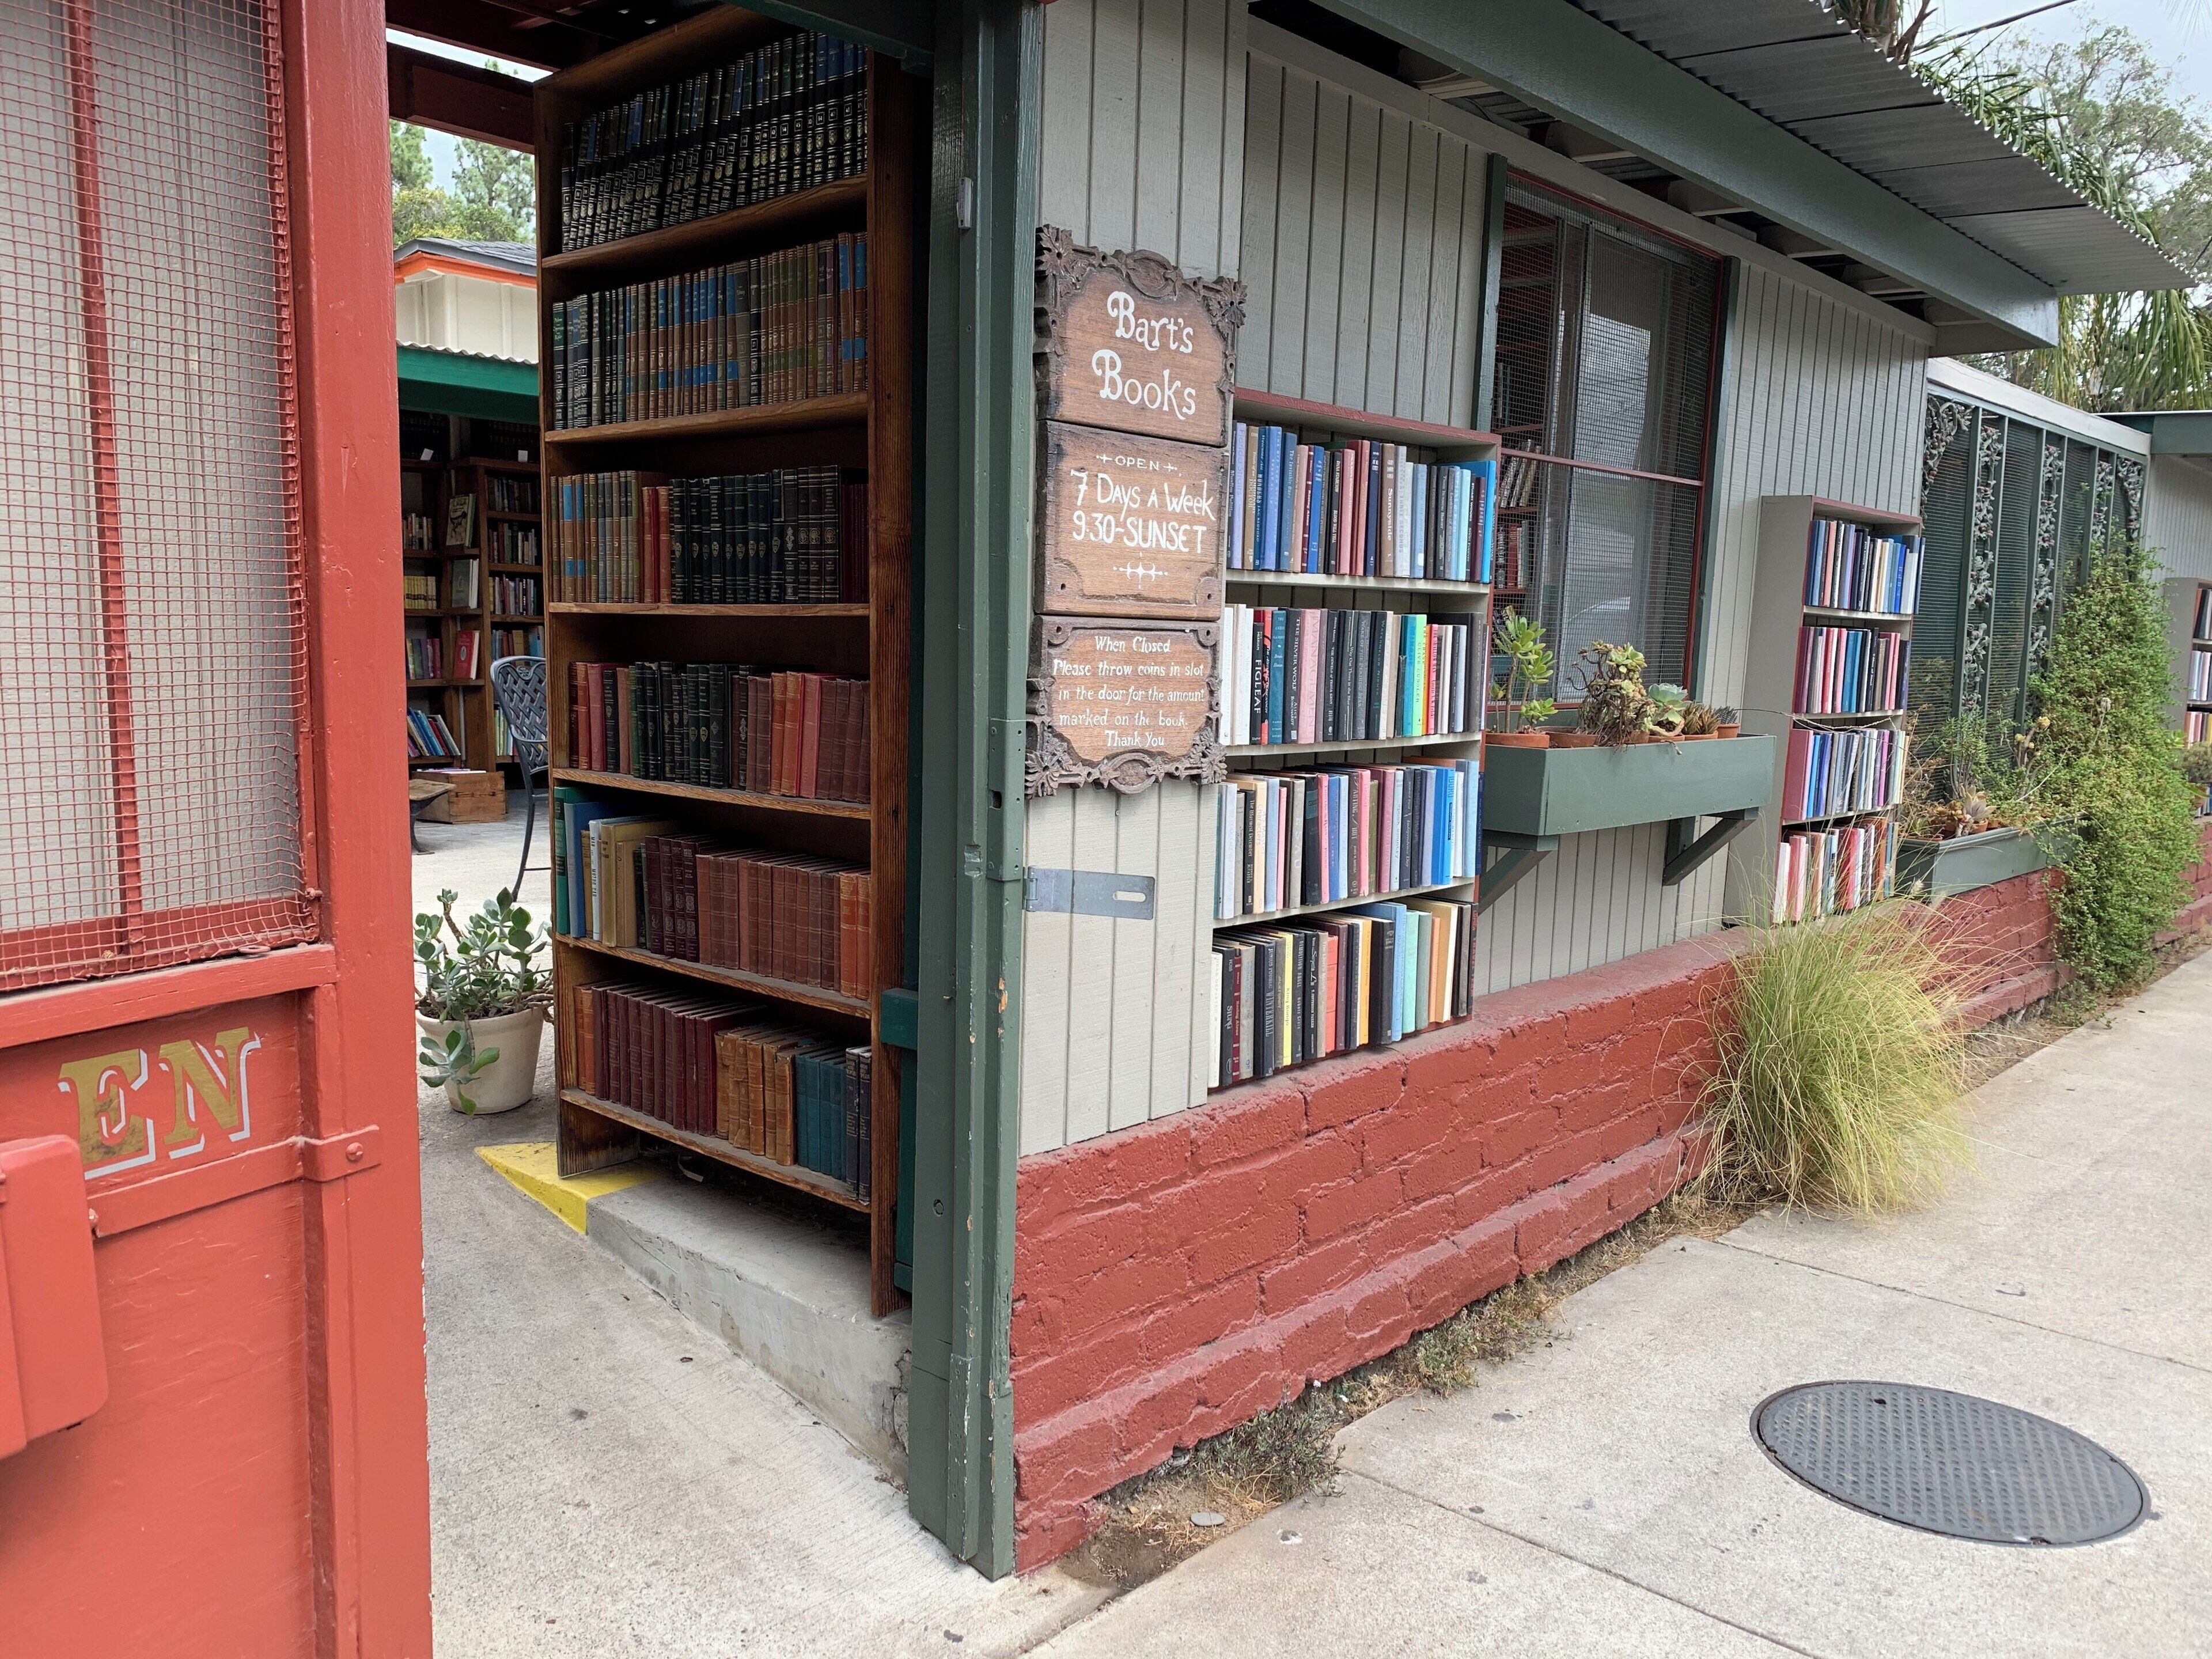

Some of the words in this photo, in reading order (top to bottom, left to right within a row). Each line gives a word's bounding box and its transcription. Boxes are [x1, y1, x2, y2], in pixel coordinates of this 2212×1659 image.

[1107, 291, 1194, 354] Bart's
[1092, 349, 1196, 421] Books
[1115, 456, 1160, 471] OPEN
[1070, 469, 1088, 506] 7
[1164, 479, 1216, 521] Week
[1094, 635, 1125, 653] When
[1132, 636, 1171, 653] Closed
[1053, 658, 1090, 676] Please
[1098, 663, 1132, 676] throw
[1138, 663, 1165, 676] coins
[1169, 663, 1180, 676] in
[1185, 663, 1204, 676] slot
[1058, 687, 1069, 700] in
[1076, 685, 1093, 700] the
[1098, 684, 1125, 700] door
[1125, 686, 1145, 706] for
[1148, 687, 1164, 702] the
[1167, 689, 1205, 702] amount
[1059, 709, 1108, 726] marked
[1115, 715, 1128, 726] on
[1135, 714, 1150, 726] the
[1104, 730, 1142, 748] Thank
[1294, 817, 1302, 869] ESAU
[1266, 991, 1274, 1037] WINTERKILL
